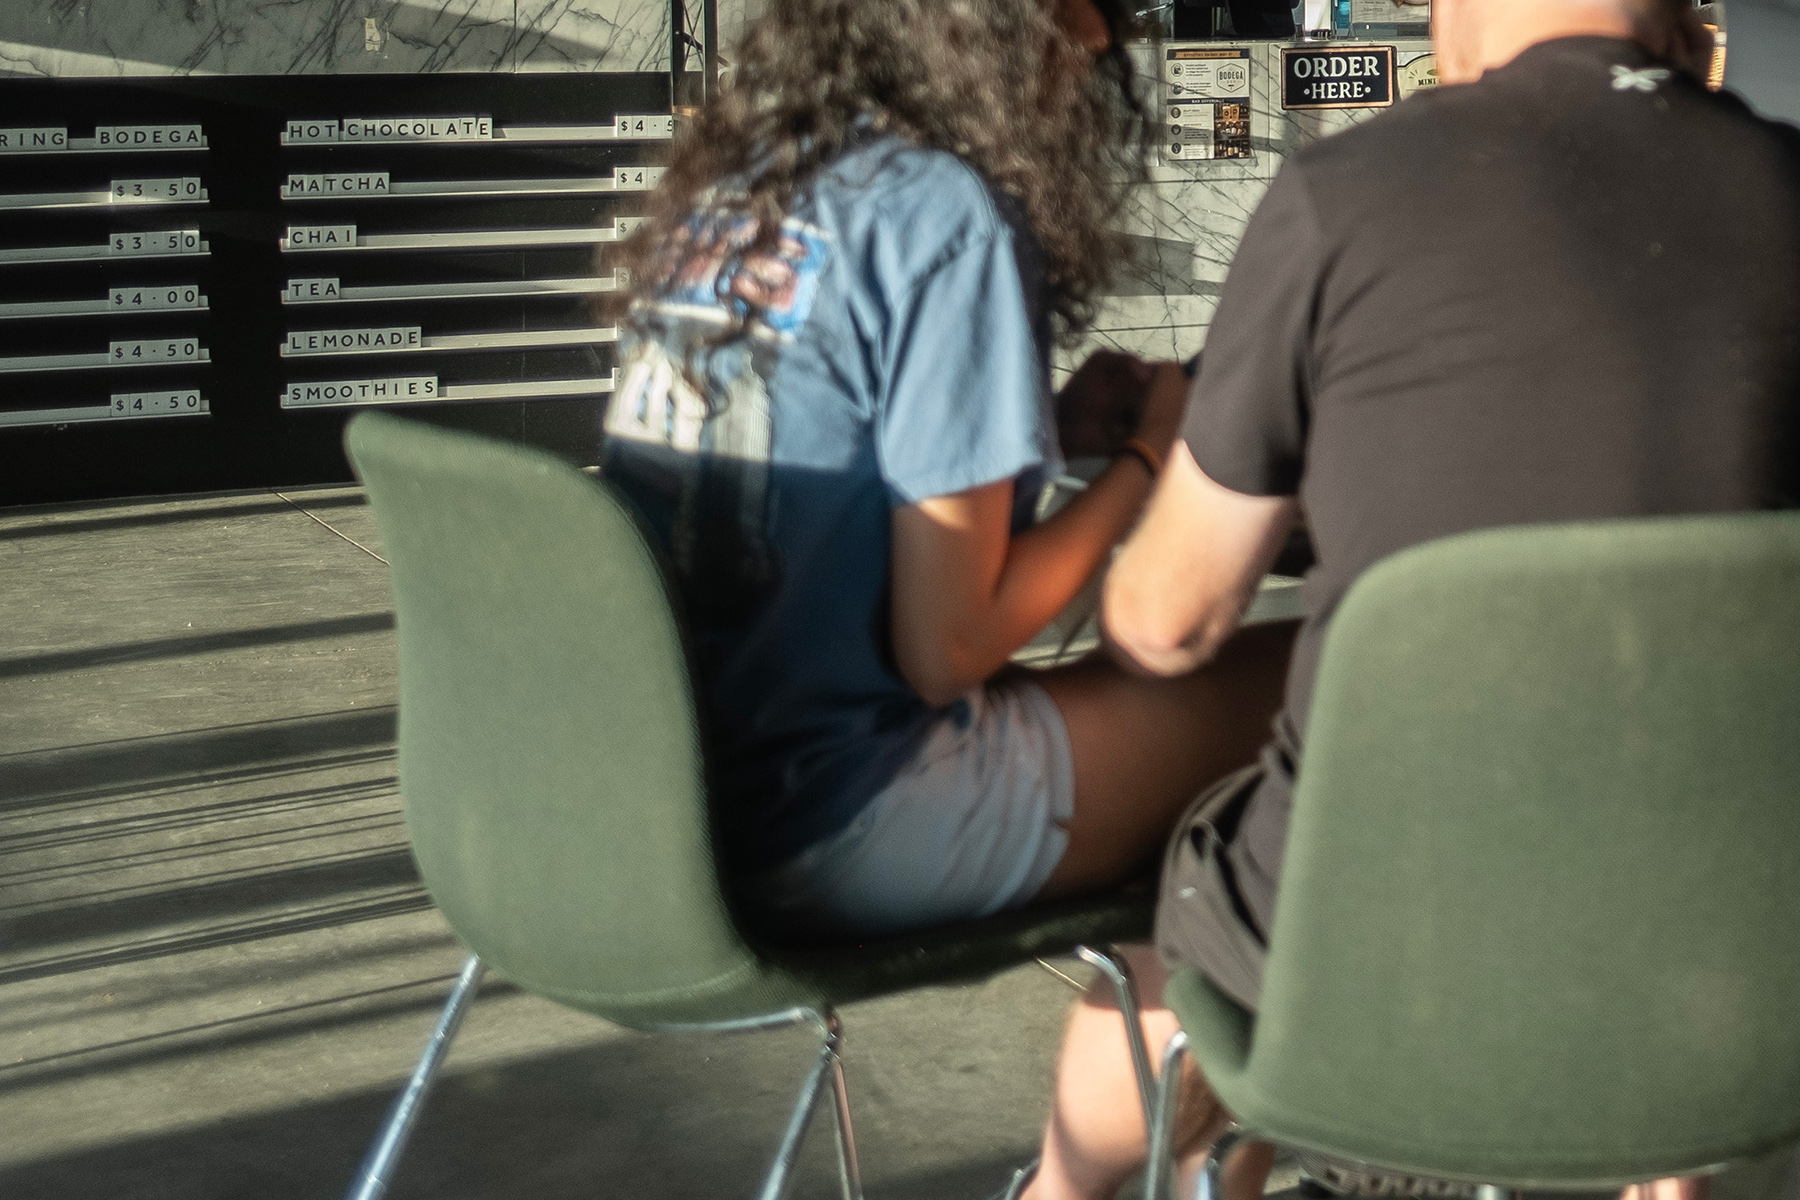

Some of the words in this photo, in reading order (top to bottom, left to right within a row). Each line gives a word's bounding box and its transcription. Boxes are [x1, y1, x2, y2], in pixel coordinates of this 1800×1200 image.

[1294, 56, 1380, 78] ORDER
[1219, 71, 1244, 80] BODEGA
[1311, 81, 1365, 99] HERE
[100, 129, 199, 145] BODEGA
[291, 125, 336, 138] HOT
[347, 122, 488, 136] CHOCOLATE
[290, 177, 386, 192] MATCHA
[292, 230, 350, 244] CHAI
[292, 282, 337, 297] TEA
[292, 331, 418, 350] LEMONADE
[292, 381, 434, 400] SMOOTHIES
